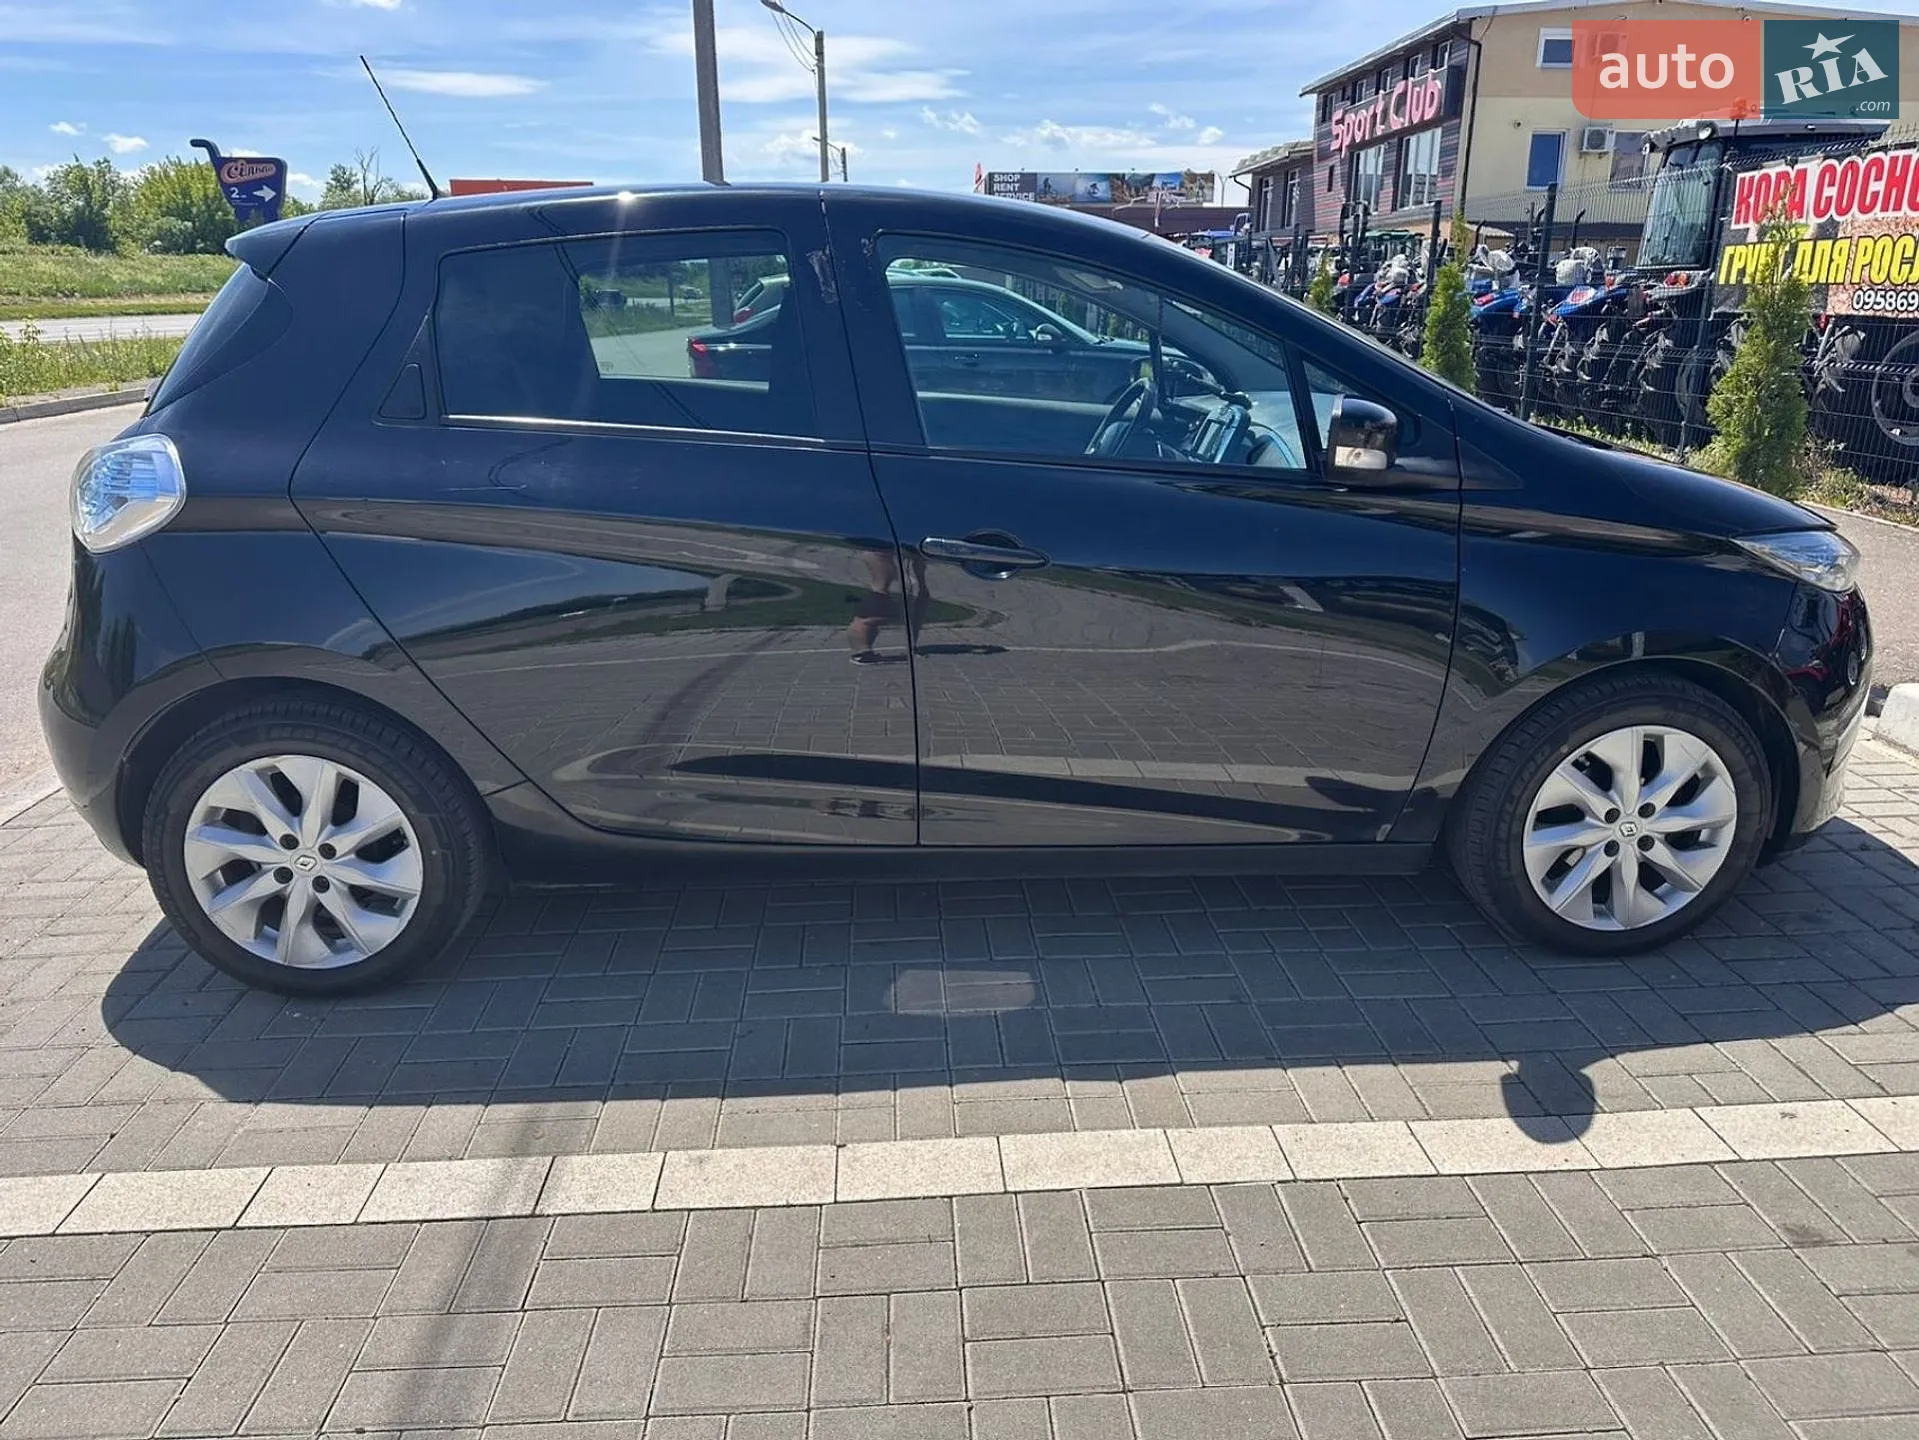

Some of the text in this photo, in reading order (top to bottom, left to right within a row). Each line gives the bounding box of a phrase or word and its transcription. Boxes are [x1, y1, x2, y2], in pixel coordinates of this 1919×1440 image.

[1330, 69, 1442, 159] Sport Club
[993, 174, 1021, 182] SHOP
[993, 183, 1020, 192] RENT
[230, 187, 240, 198] 2
[1734, 168, 1808, 225] КОРА
[1792, 238, 1852, 284] ДЛЯ
[1853, 289, 1919, 312] 095869
